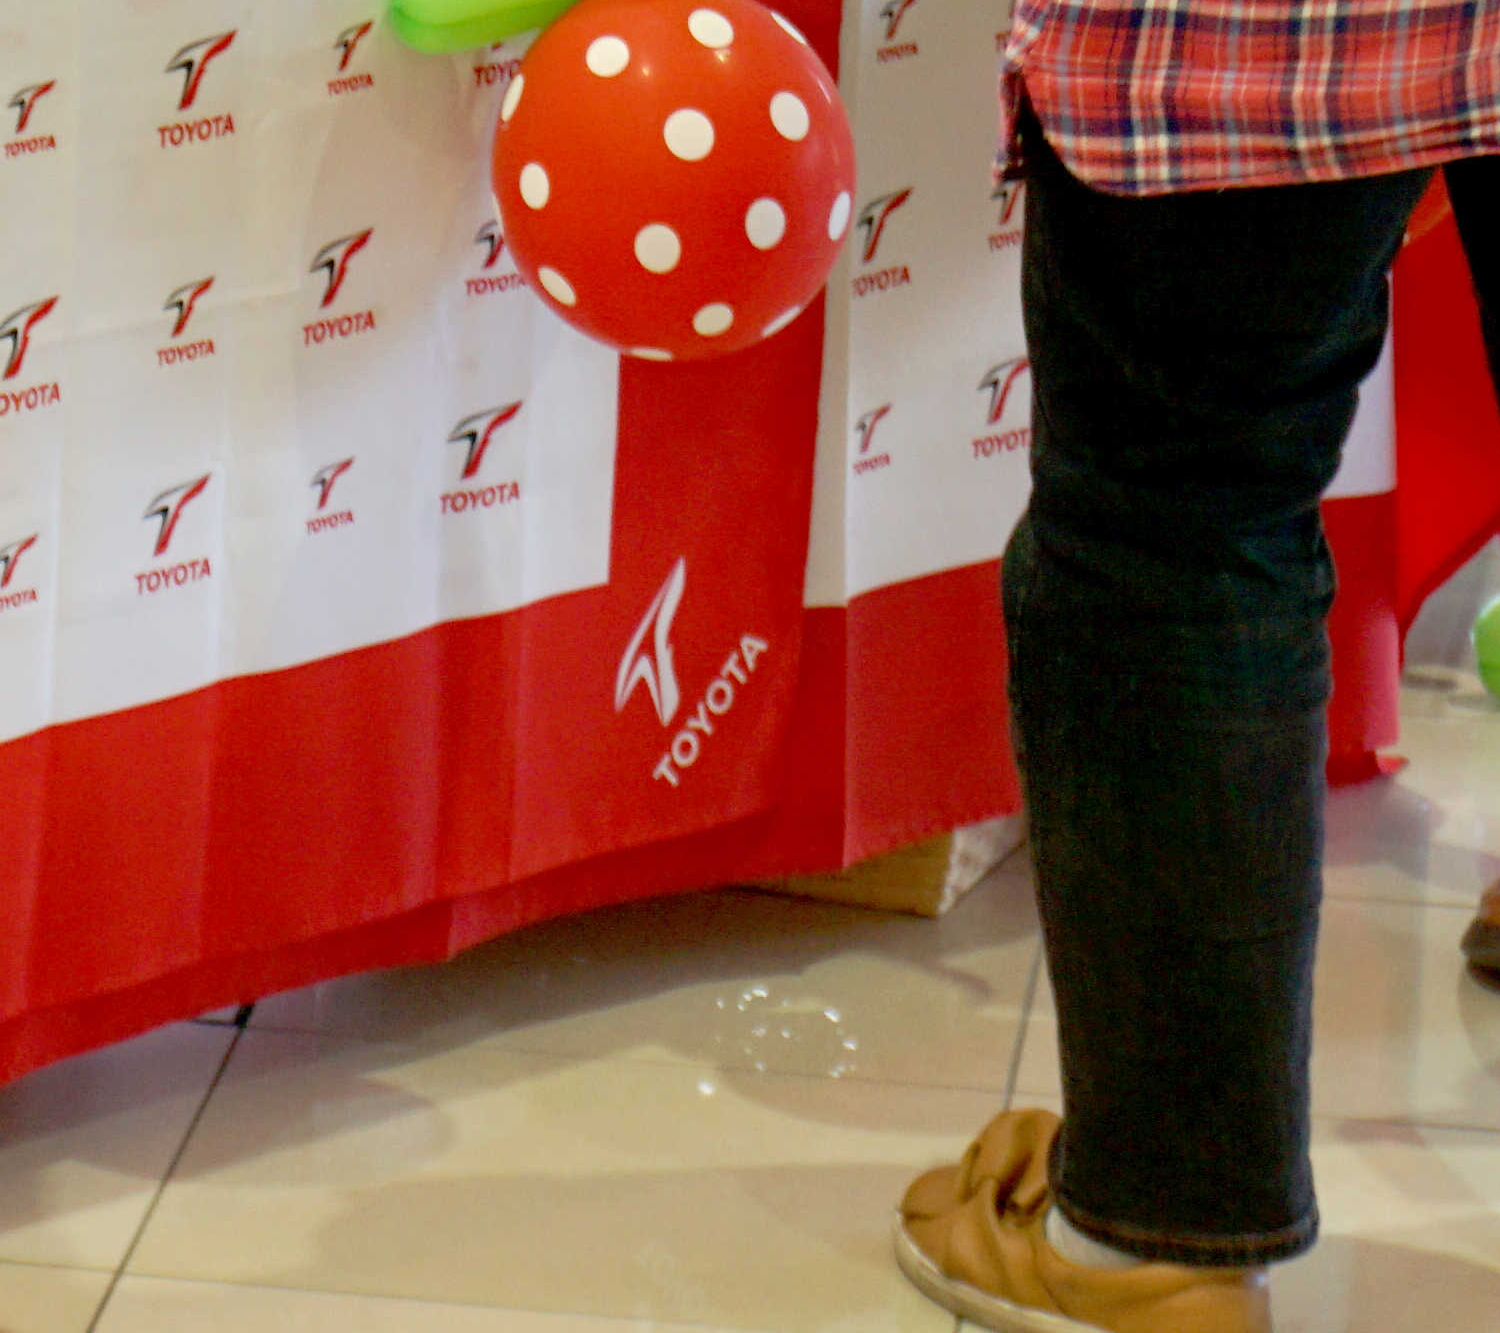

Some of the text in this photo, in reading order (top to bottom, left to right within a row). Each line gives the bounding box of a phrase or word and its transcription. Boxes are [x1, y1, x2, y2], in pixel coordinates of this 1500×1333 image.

[876, 41, 920, 62] TOYOTA
[327, 72, 375, 94] TOYOTA
[157, 112, 236, 147] TOYOTA
[3, 134, 57, 158] TOYOTA
[987, 226, 1027, 249] TOYO
[852, 264, 911, 295] TOYOTA
[303, 308, 376, 345] TOYOTA
[156, 337, 216, 365] TOYOTA
[972, 427, 1032, 459] TOYOT
[852, 452, 892, 474] TOYOTA
[439, 480, 521, 513] TOYOTA
[306, 510, 355, 533] TOYOTA
[135, 557, 212, 593] TOYOTA
[651, 632, 770, 787] TOYOTA
